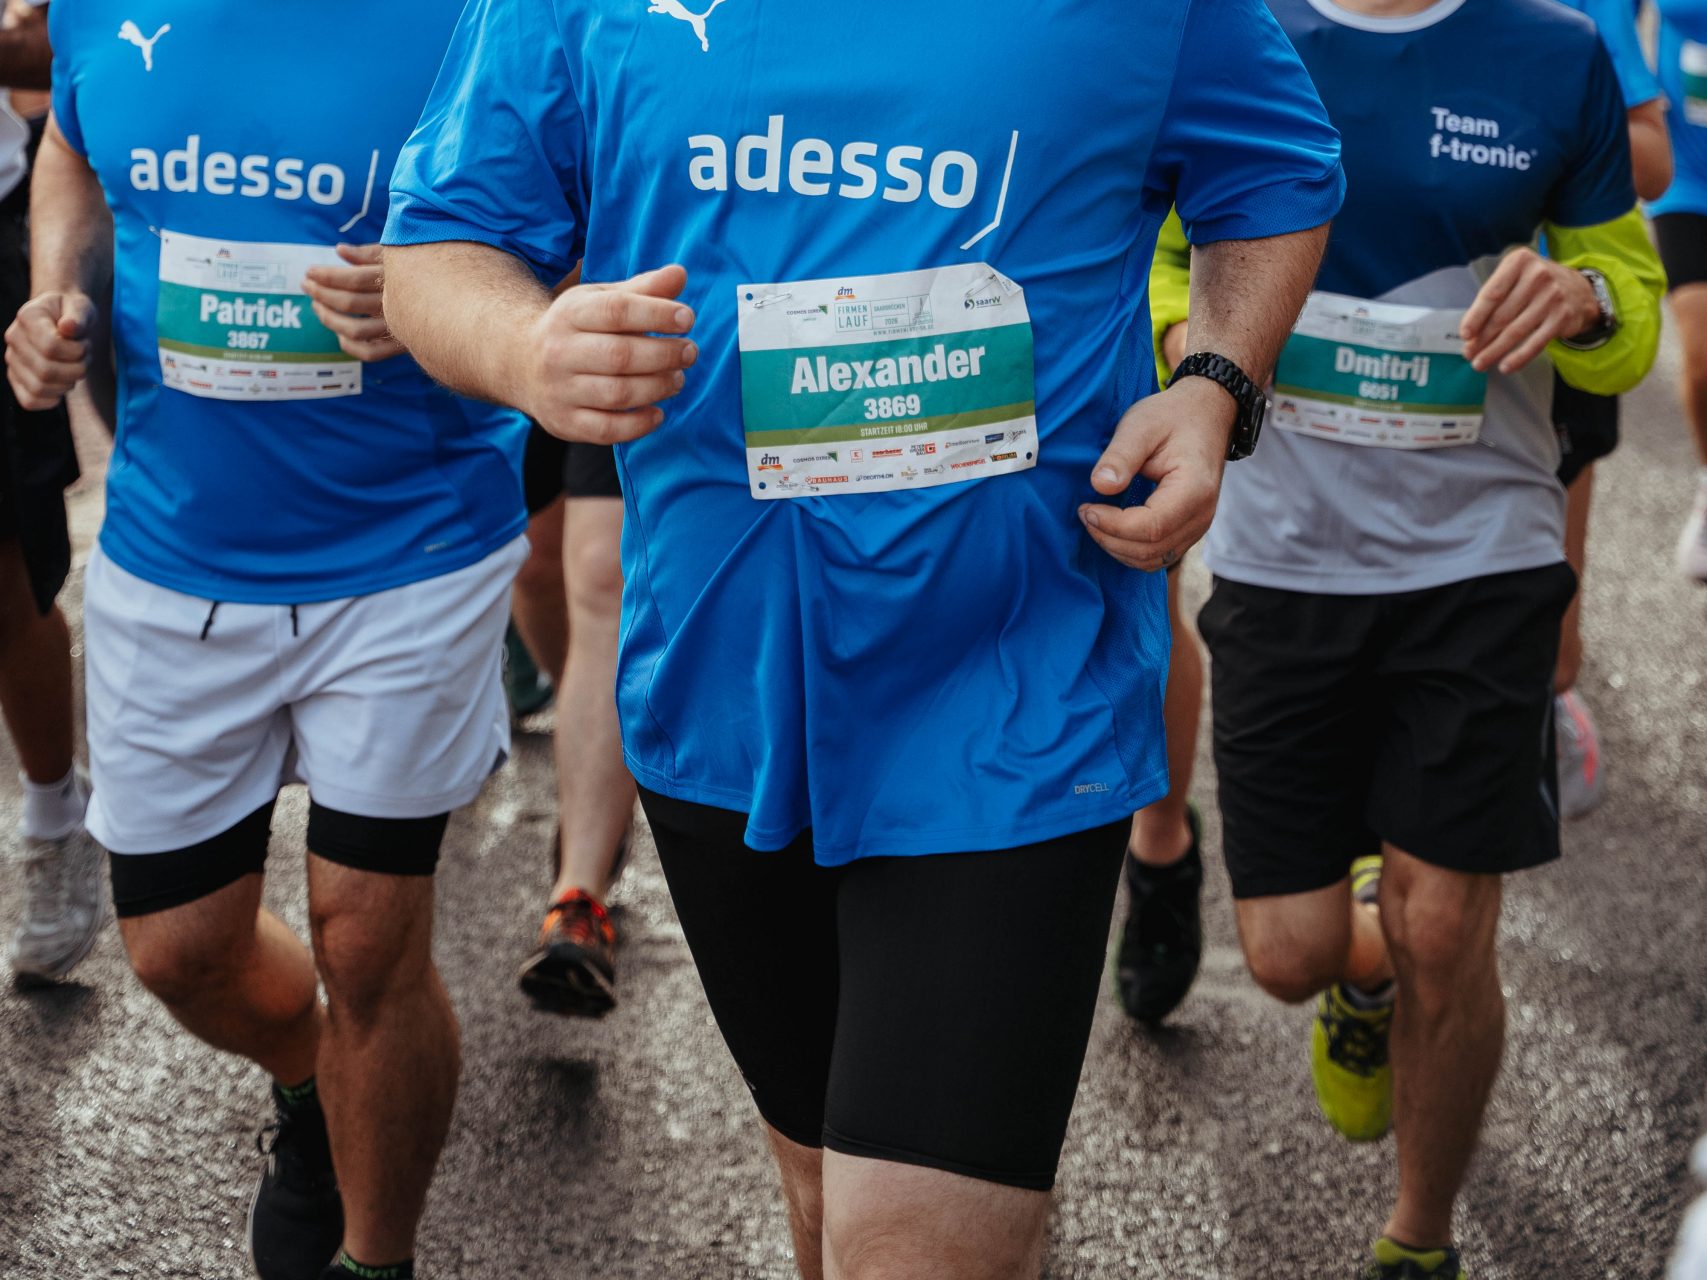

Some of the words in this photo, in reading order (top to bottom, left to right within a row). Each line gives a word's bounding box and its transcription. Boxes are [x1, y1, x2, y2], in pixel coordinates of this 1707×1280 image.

[1430, 106, 1499, 138] Team
[688, 114, 978, 209] adesso
[1429, 133, 1531, 171] f-tronic
[130, 134, 345, 205] adesso
[838, 287, 853, 296] dm
[200, 293, 302, 329] Patrick
[838, 304, 868, 314] FIRMEN
[838, 315, 868, 328] LAUF
[227, 330, 270, 349] 3867
[790, 344, 985, 394] Alexander
[1334, 346, 1430, 387] Dmitrij
[864, 393, 921, 420] 3869
[860, 425, 894, 437] STARTZEIT
[914, 422, 928, 432] UHR
[760, 453, 780, 465] dm
[1074, 783, 1109, 795] DRYCELL
